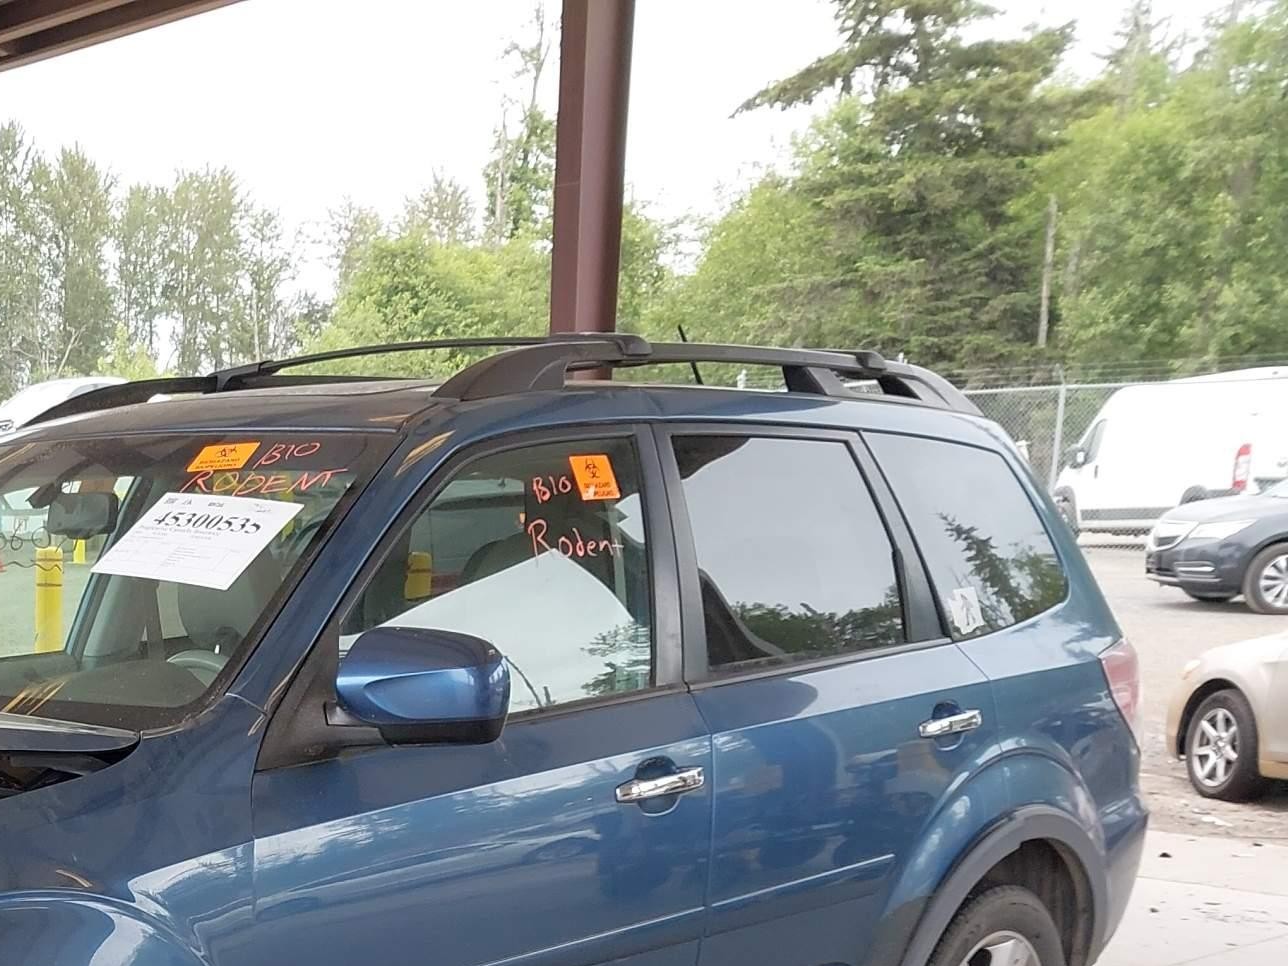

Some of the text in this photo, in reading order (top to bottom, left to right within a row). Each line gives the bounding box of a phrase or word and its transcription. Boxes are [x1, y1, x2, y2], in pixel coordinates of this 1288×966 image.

[180, 468, 349, 496] RODENT
[153, 511, 261, 534] 45300535
[528, 519, 624, 567] Rodent
